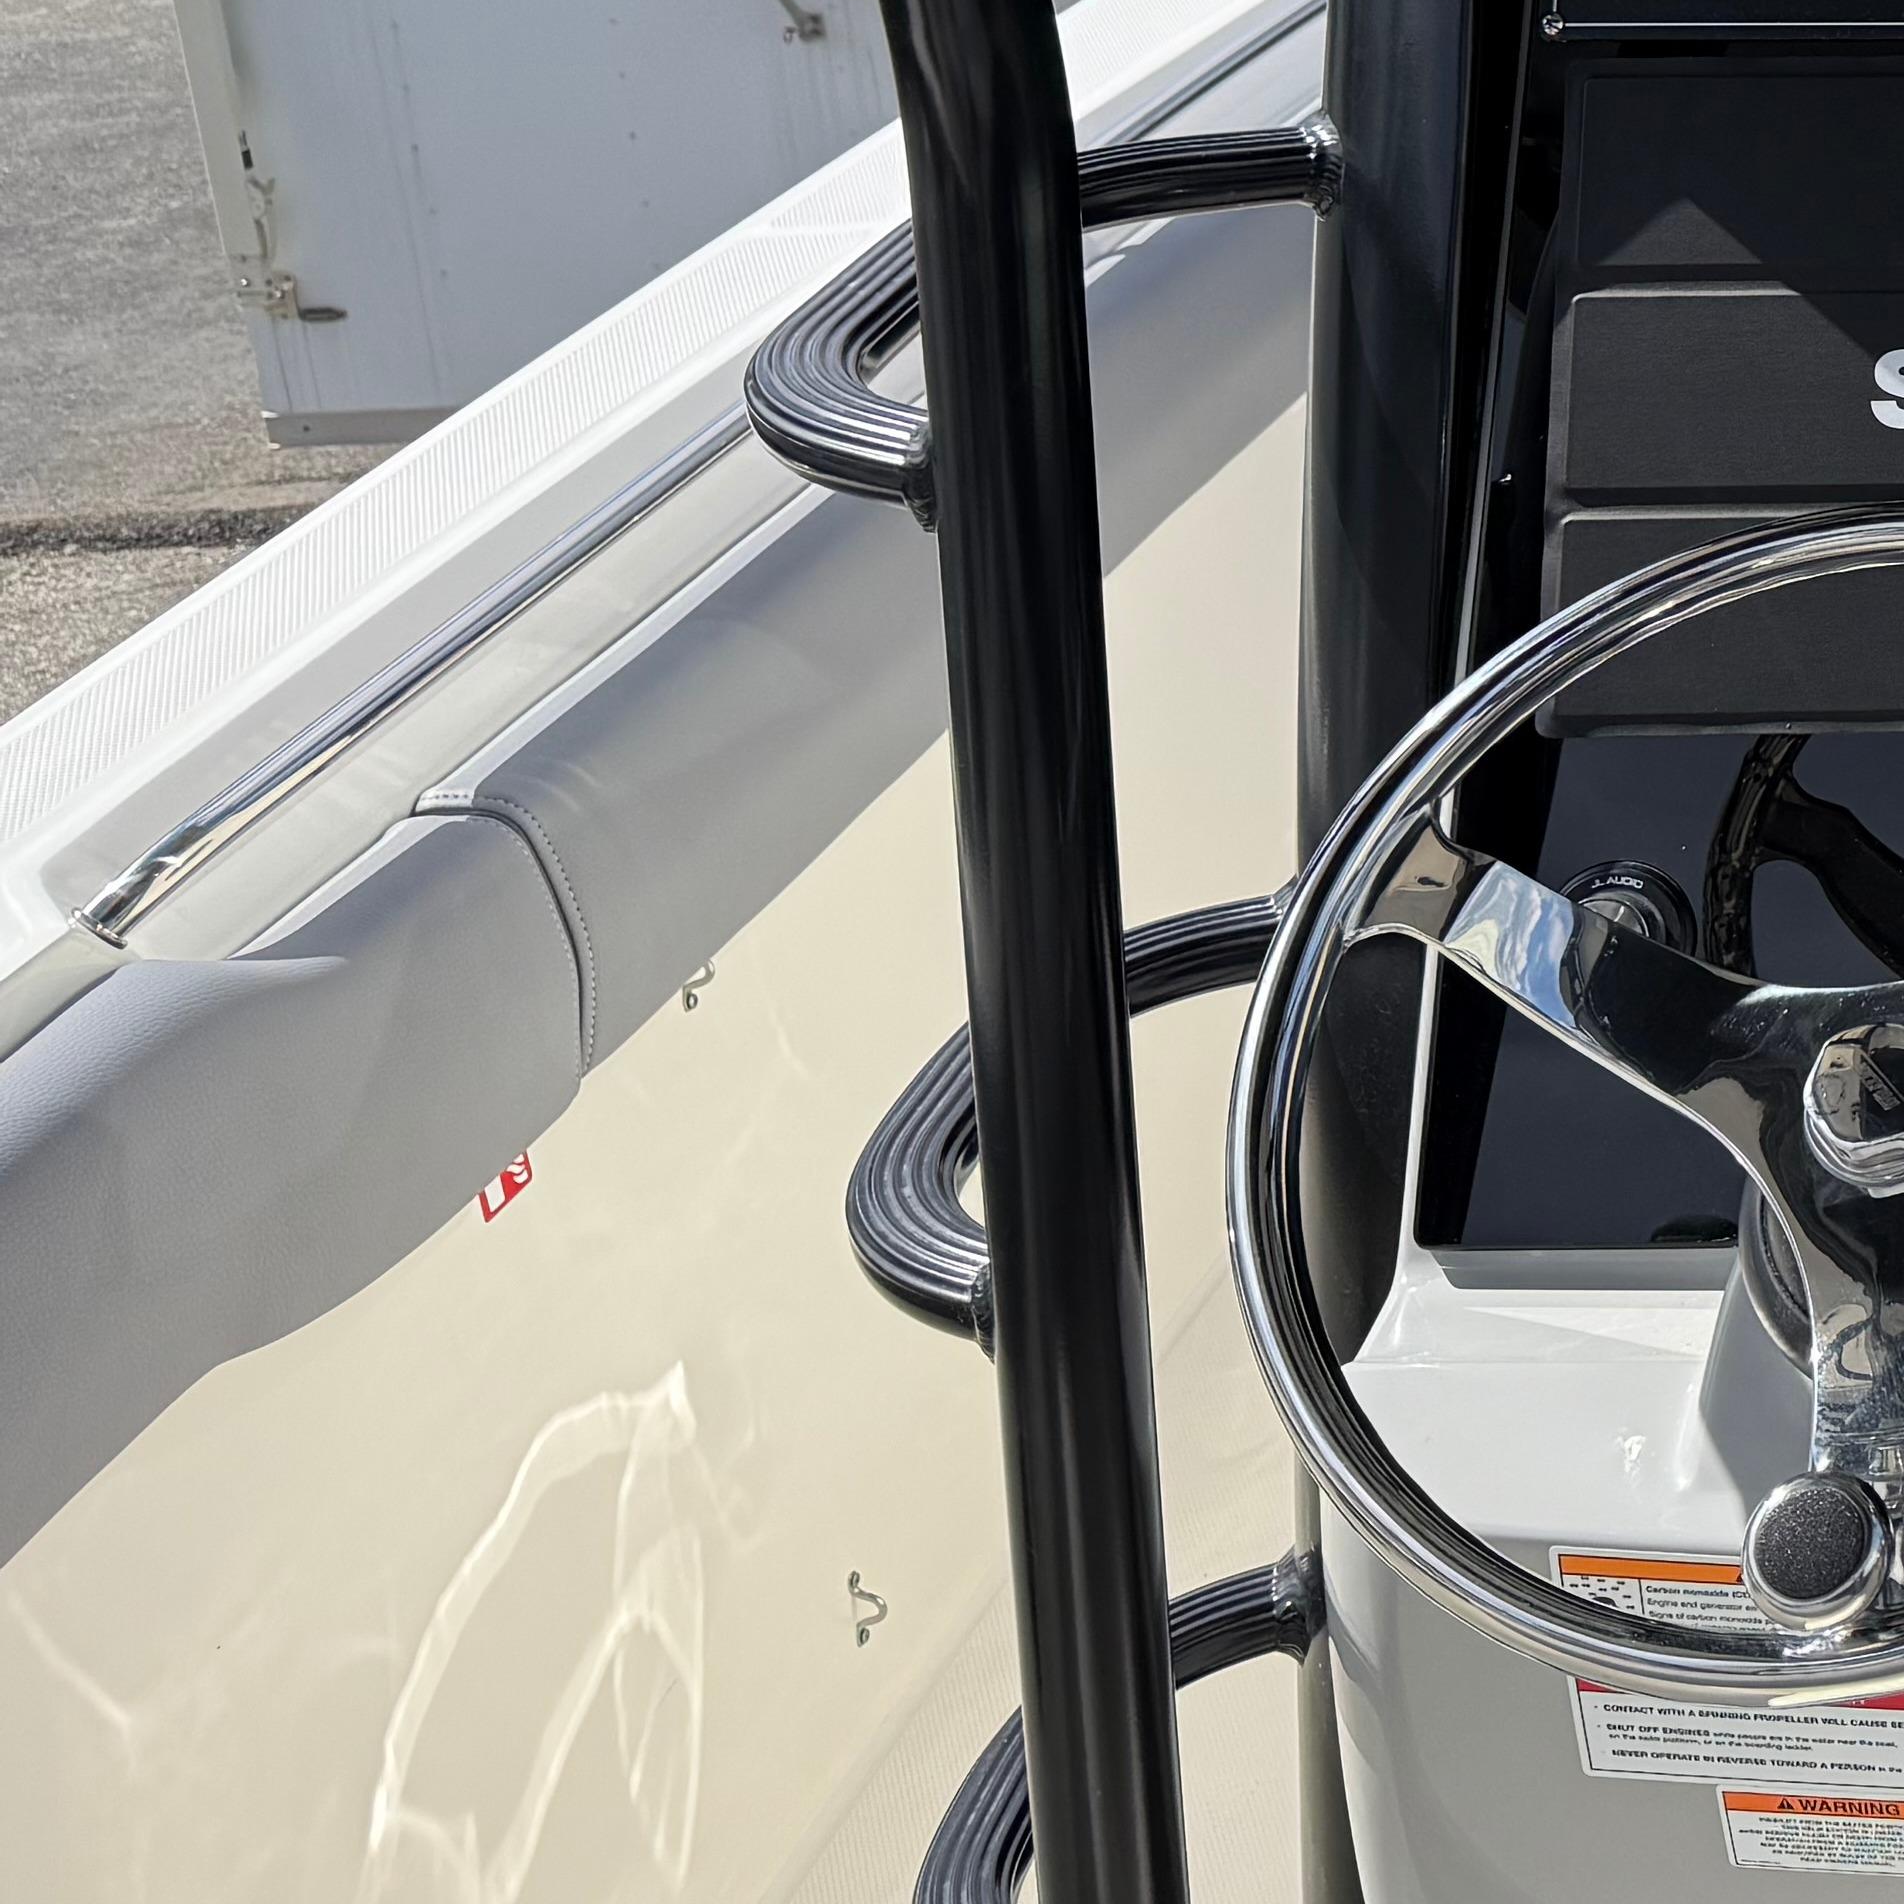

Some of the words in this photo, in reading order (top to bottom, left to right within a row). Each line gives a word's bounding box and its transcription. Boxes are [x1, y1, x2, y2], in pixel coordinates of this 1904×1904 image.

[1606, 876, 1644, 889] AUDIO
[1645, 1585, 1680, 1595] Carbon
[1603, 1704, 1654, 1715] CONTACT
[1657, 1708, 1685, 1716] WITH
[1688, 1709, 1696, 1717] A
[1753, 1713, 1818, 1724] PROPELLER
[1821, 1717, 1848, 1726] WILL
[1850, 1719, 1888, 1728] CAUSE
[1606, 1723, 1635, 1732] SHUT
[1638, 1725, 1659, 1733] OFF
[1650, 1751, 1700, 1761] OPERATE
[1770, 1759, 1817, 1769] TOWARD
[1830, 1762, 1876, 1771] PERSON
[1798, 1798, 1900, 1816] WARNING
